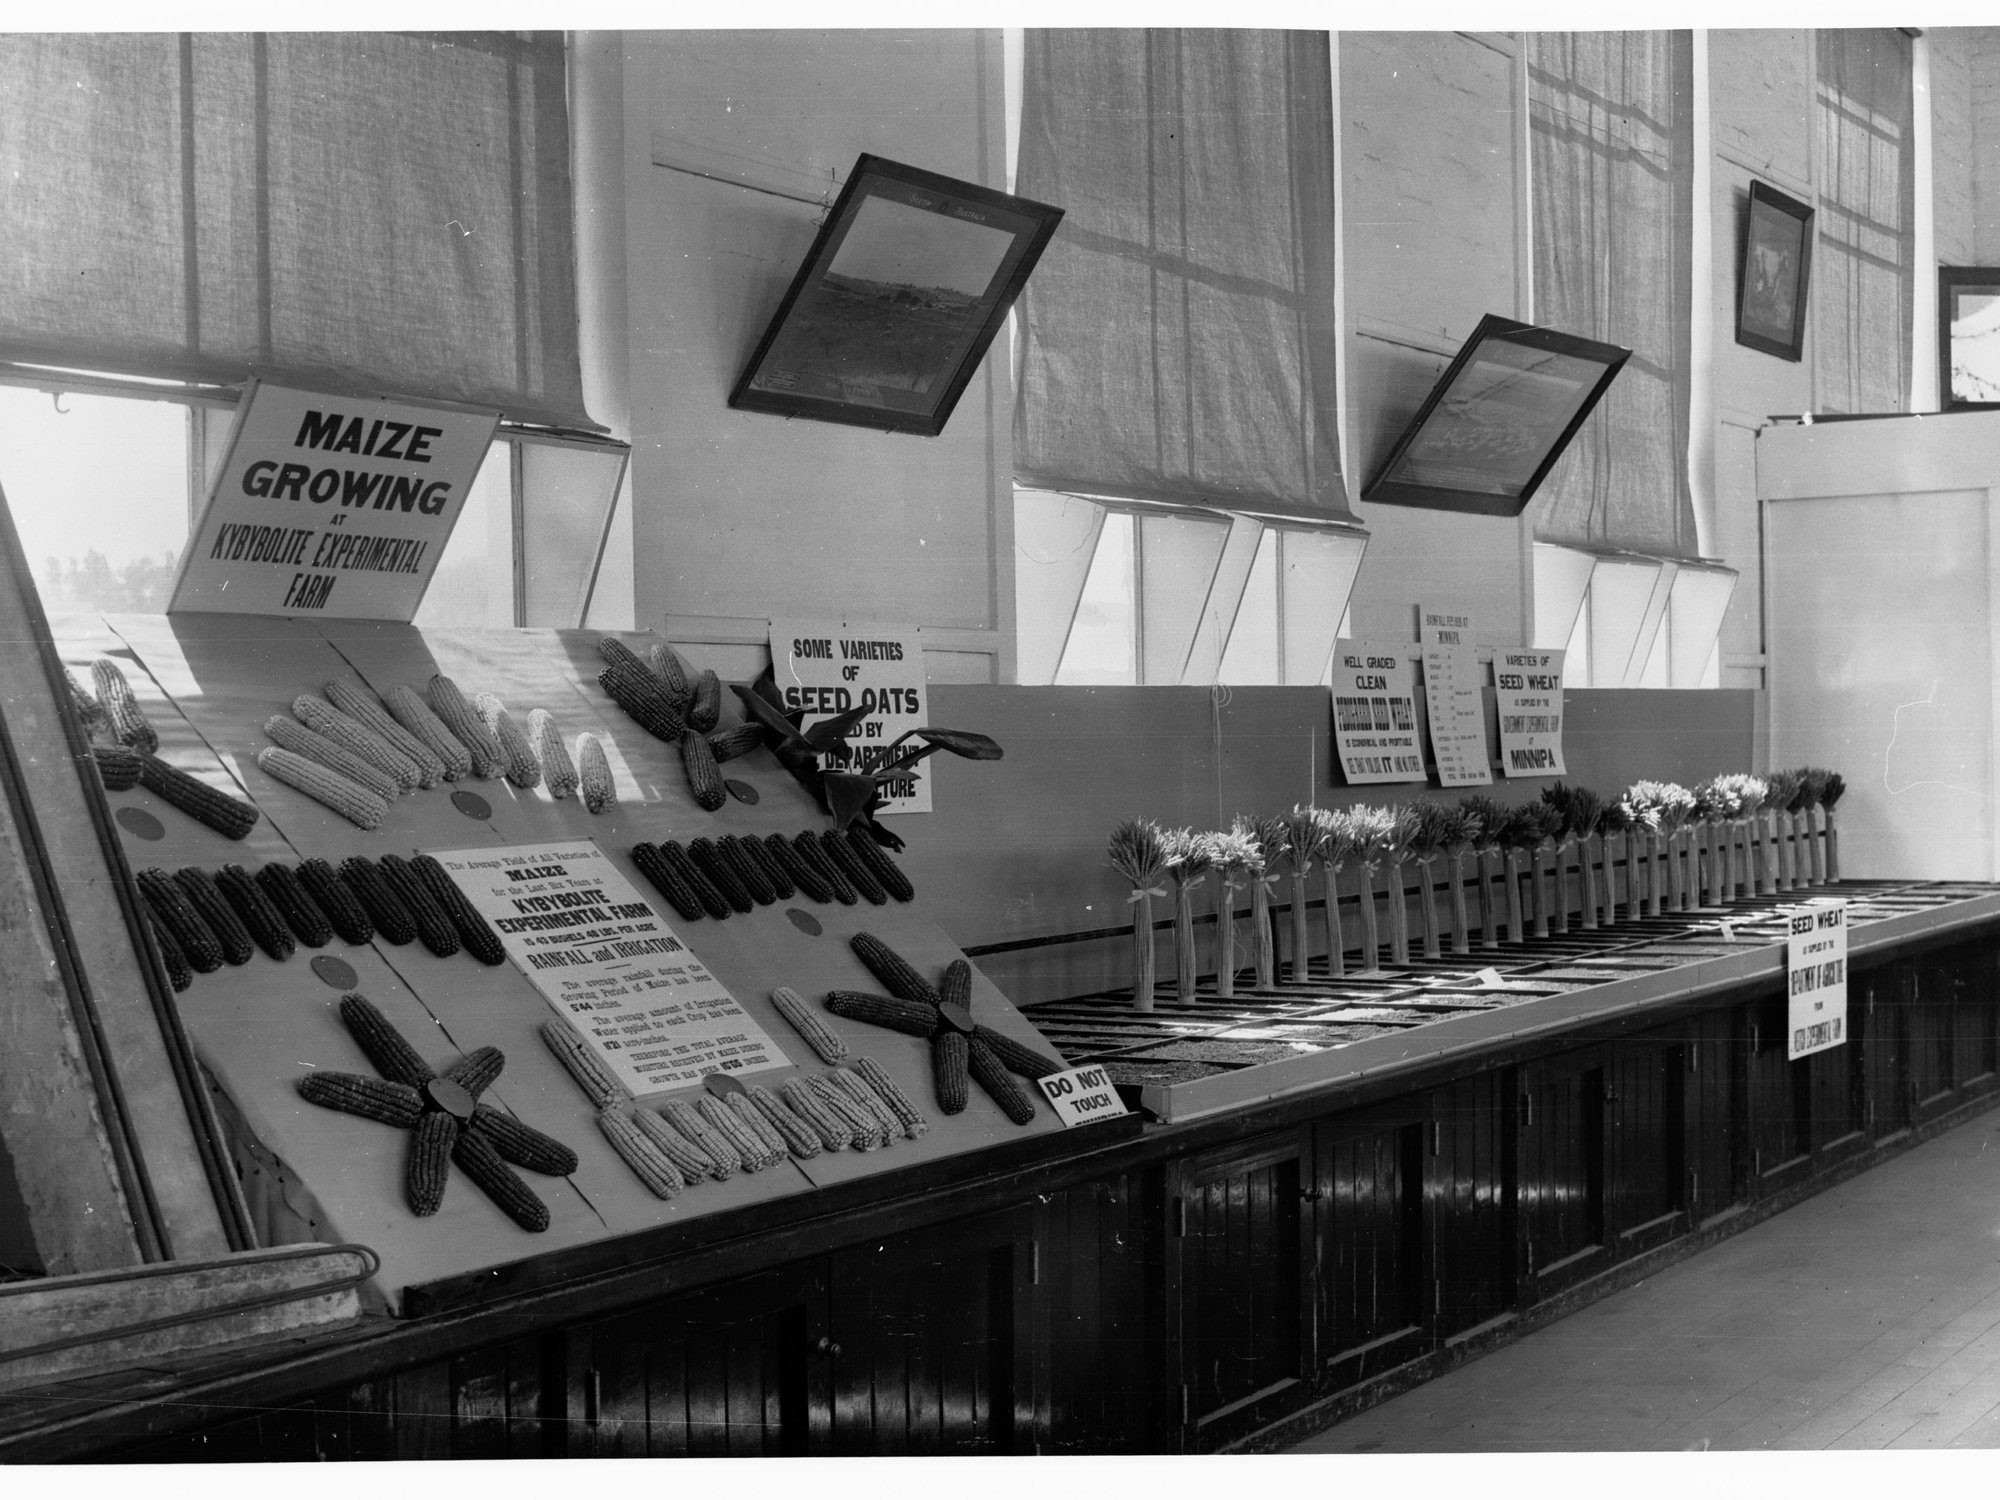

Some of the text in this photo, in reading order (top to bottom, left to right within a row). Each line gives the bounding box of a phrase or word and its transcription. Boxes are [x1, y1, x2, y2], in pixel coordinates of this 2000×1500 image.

[294, 410, 443, 463] MAIZE
[242, 460, 452, 516] GROWING
[329, 513, 347, 526] AT
[210, 522, 428, 574] KYBYBOLITE EXPERIMENTAL
[283, 573, 337, 609] FARM
[793, 639, 904, 661] SOME VARIETIES
[1344, 656, 1396, 669] WELL GRADED
[1540, 656, 1550, 667] OF
[842, 665, 860, 681] OF
[1355, 675, 1387, 690] CLEAN
[1500, 674, 1559, 690] SEED WHEAT
[785, 686, 920, 715] SEED OATS
[866, 722, 883, 738] BY
[1510, 748, 1556, 770] MINNIPA
[445, 850, 601, 871] The Average Yield of All Varieties of
[505, 865, 568, 882] MAIZE
[491, 888, 506, 897] for
[507, 886, 524, 895] the
[524, 883, 547, 893] Last
[550, 881, 565, 890] Six
[565, 878, 592, 888] Years
[511, 889, 611, 914] KYBYBOLITE
[494, 902, 654, 934] EXPERIMENTAL FARM
[1791, 908, 1844, 936] SEED WHEAT
[547, 932, 586, 944] BUSHELS
[598, 927, 619, 937] LBS.
[617, 925, 636, 934] PER
[635, 922, 658, 932] ACRE
[526, 936, 684, 970] RAINFALL and IRRIGATION
[561, 964, 703, 990] The average rainfall during the
[561, 974, 712, 1001] Growing Period of Maize has been
[591, 1028, 620, 1037] Water
[621, 1022, 652, 1035] applied
[652, 1021, 664, 1029] to
[666, 1016, 687, 1026] each
[686, 1012, 707, 1022] Crop
[706, 1009, 724, 1018] has
[592, 998, 734, 1025] The average amount of Irrigation
[629, 1034, 748, 1061] THEREFORE THE TOTAL AVERAGE
[633, 1061, 670, 1073] MOISTURE
[669, 1054, 705, 1068] RECEIVED
[704, 1051, 717, 1060] BY
[717, 1047, 740, 1057] MAIZE
[648, 1072, 681, 1084] GROWTH
[680, 1070, 698, 1079] HAS
[1044, 1069, 1108, 1099] DO NOT
[1070, 1093, 1113, 1114] TOUCH
